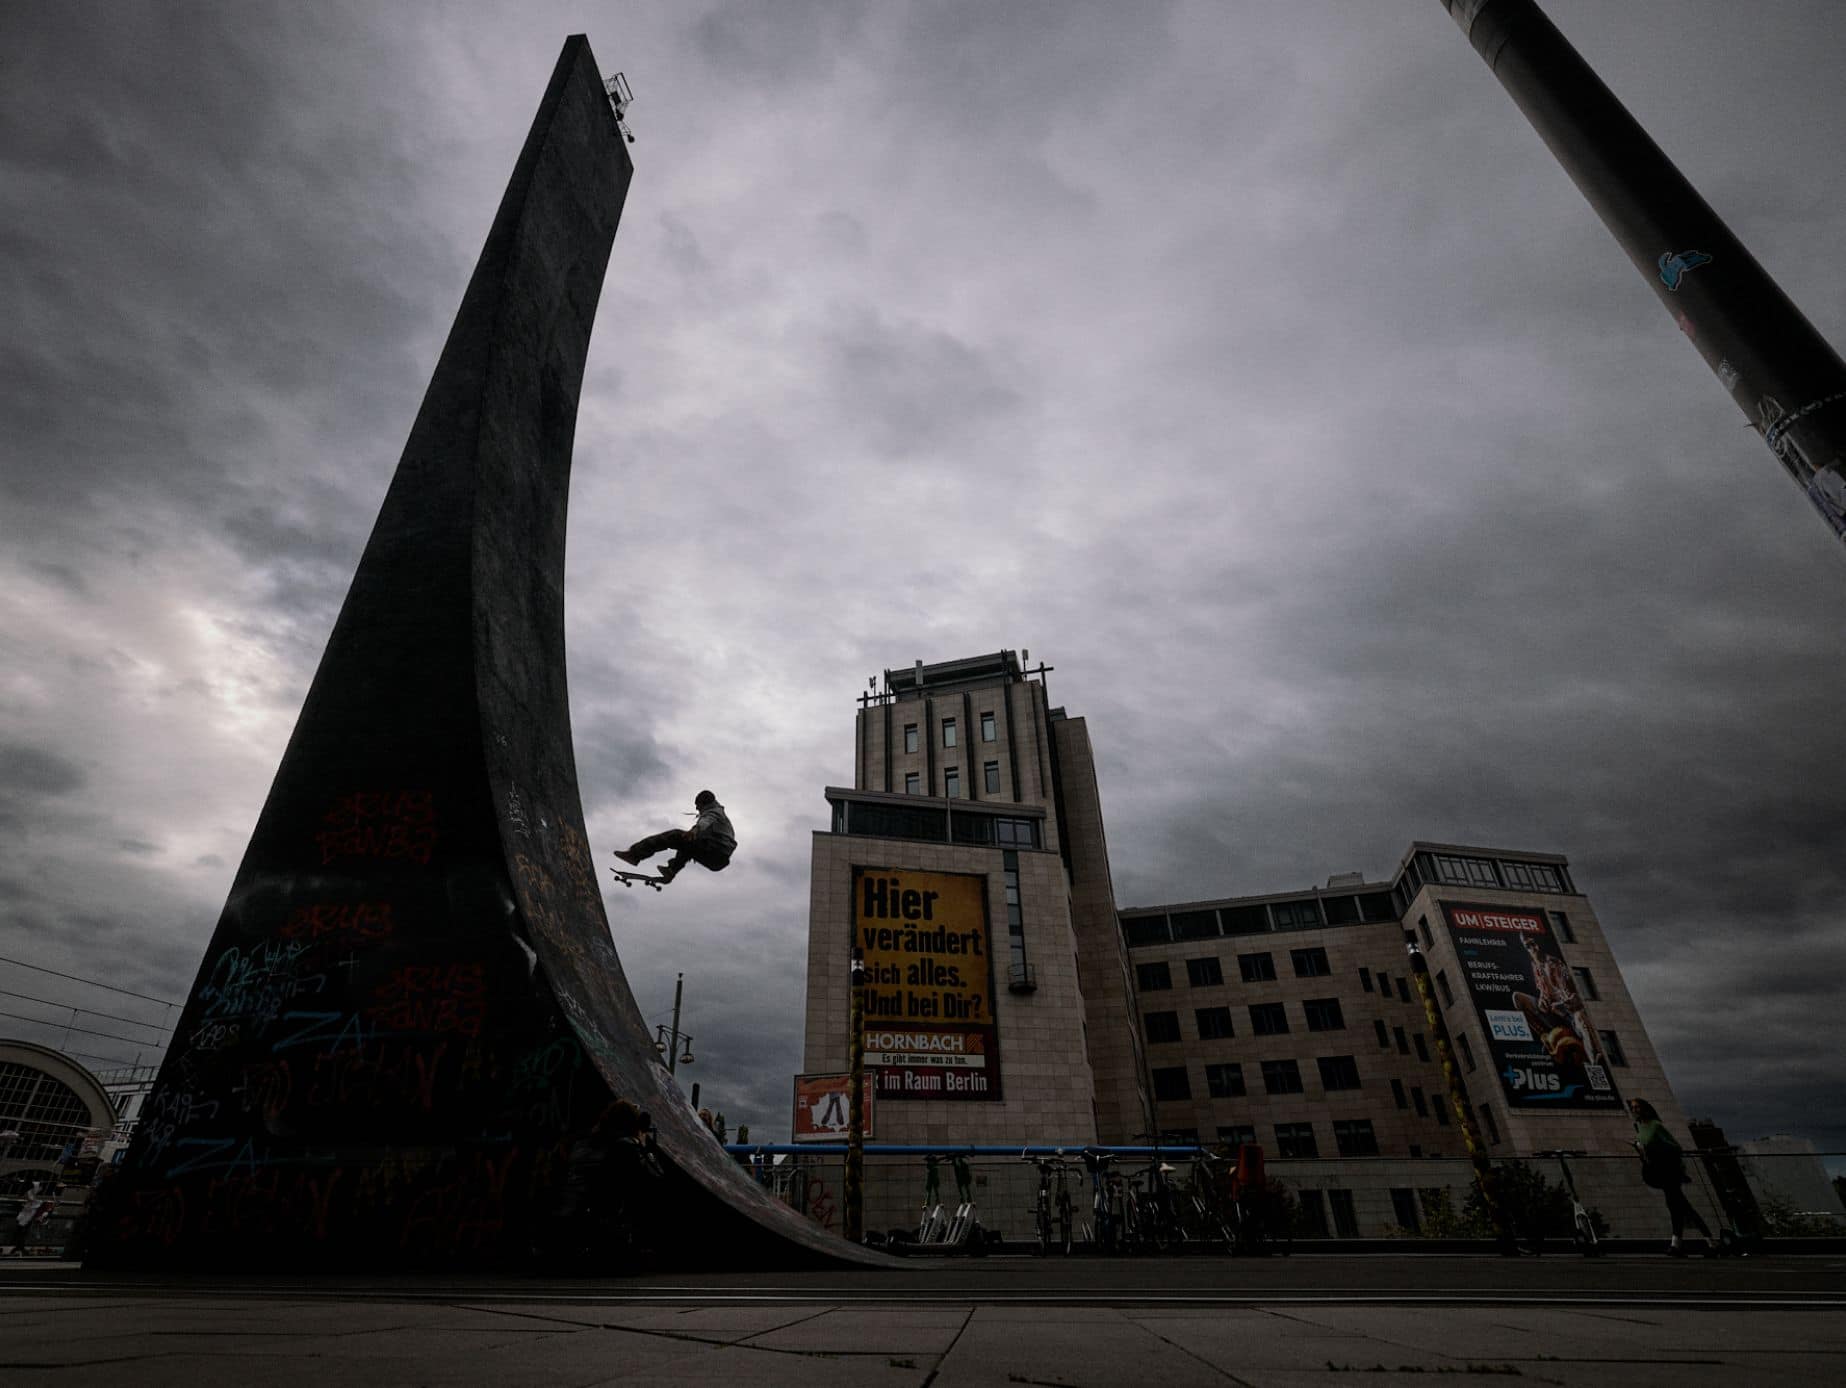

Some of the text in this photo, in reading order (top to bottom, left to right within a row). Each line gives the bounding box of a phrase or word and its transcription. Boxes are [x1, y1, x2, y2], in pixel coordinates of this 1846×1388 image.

[864, 877, 939, 919] Hier
[863, 924, 983, 956] verändert
[863, 958, 968, 987] sich alles.
[863, 989, 982, 1018] Und bei Dir?
[866, 1032, 964, 1051] HORNBACH
[882, 1053, 890, 1063] Es
[892, 1054, 906, 1065] gibt
[908, 1054, 928, 1064] immer
[930, 1056, 943, 1064] was
[945, 1056, 953, 1065] zu
[884, 1070, 900, 1090] im
[904, 1070, 941, 1091] Raum
[945, 1072, 988, 1092] Berlin
